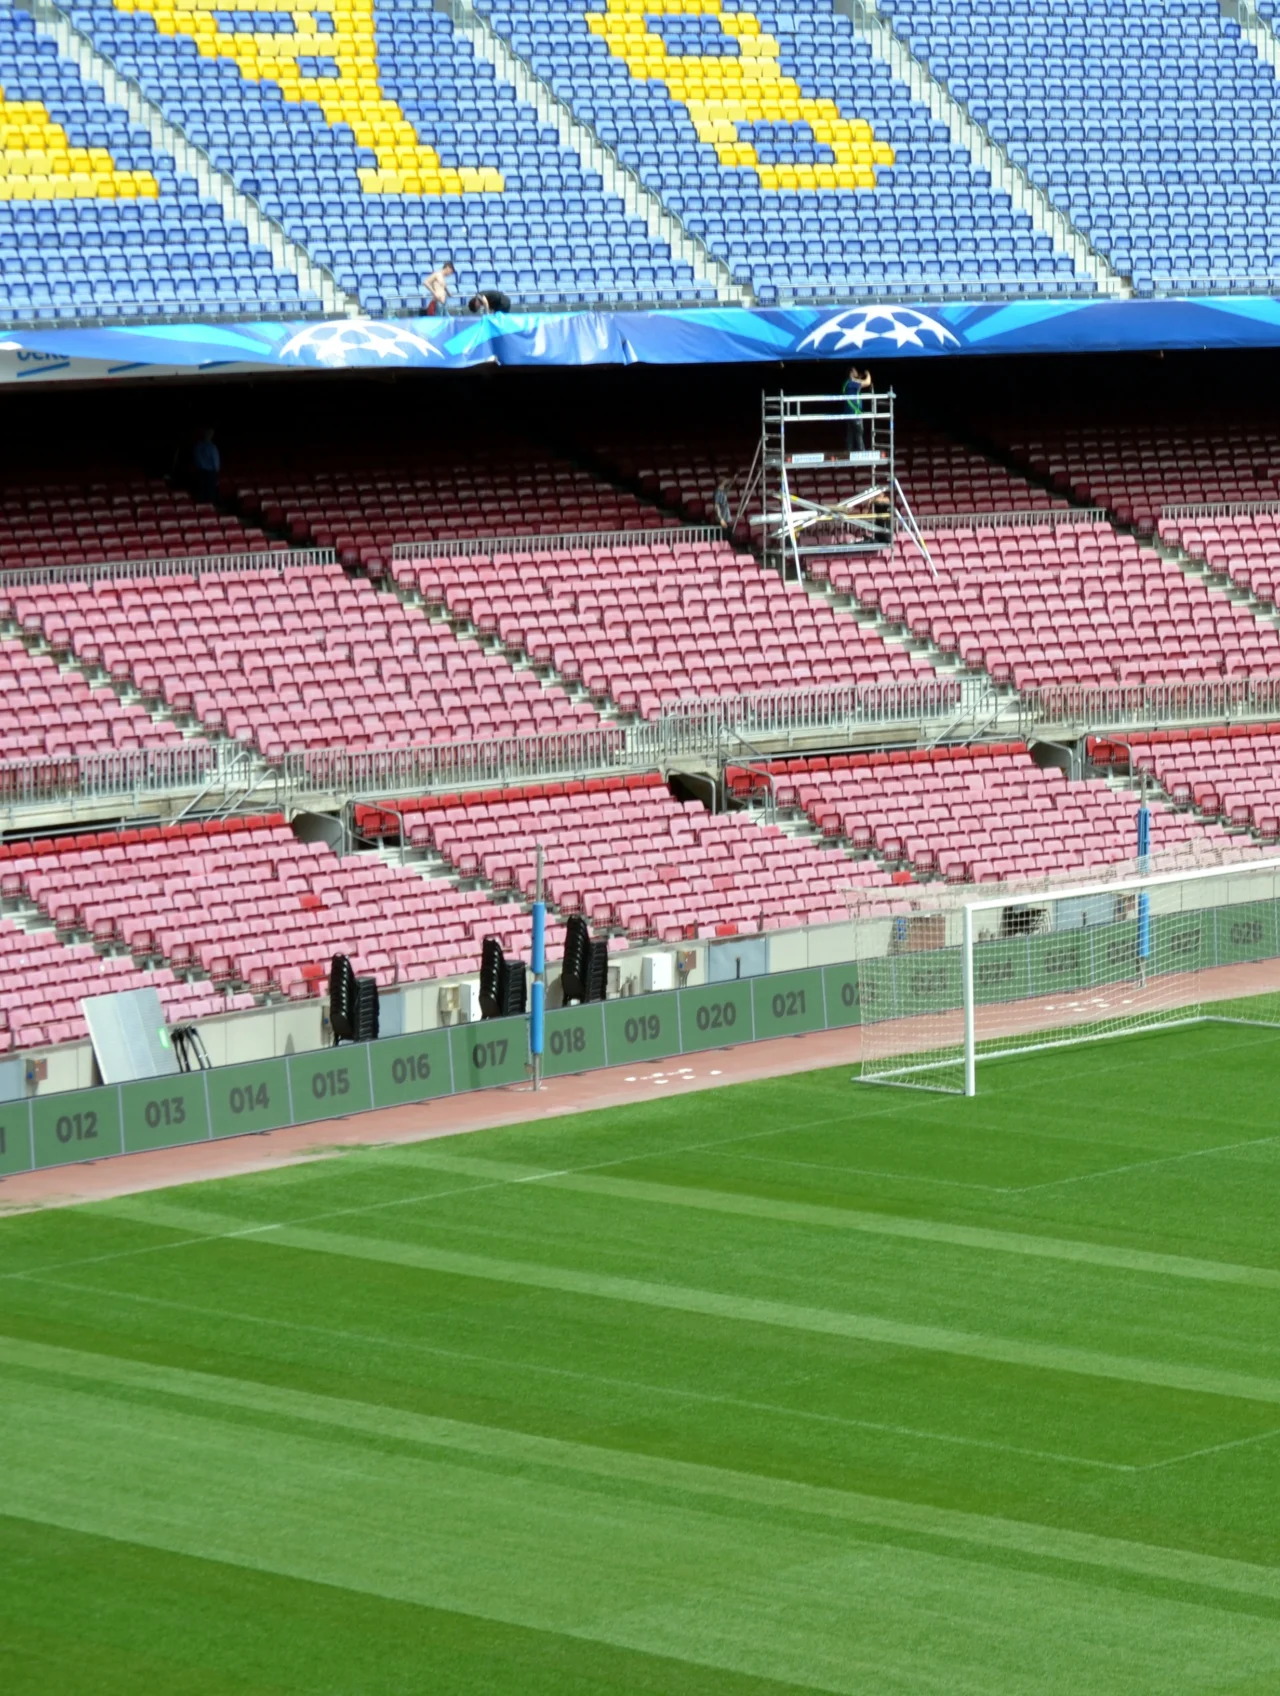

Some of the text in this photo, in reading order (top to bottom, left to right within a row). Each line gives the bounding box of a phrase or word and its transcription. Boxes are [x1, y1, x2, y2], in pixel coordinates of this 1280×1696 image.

[696, 1001, 737, 1031] 020
[771, 989, 806, 1019] 021
[549, 1026, 586, 1056] 018
[624, 1014, 661, 1044] 019
[391, 1053, 431, 1085] 016
[471, 1039, 508, 1069] 017
[229, 1082, 270, 1114] 014
[311, 1067, 351, 1100] 015
[55, 1111, 98, 1144] 012
[144, 1096, 186, 1129] 013
